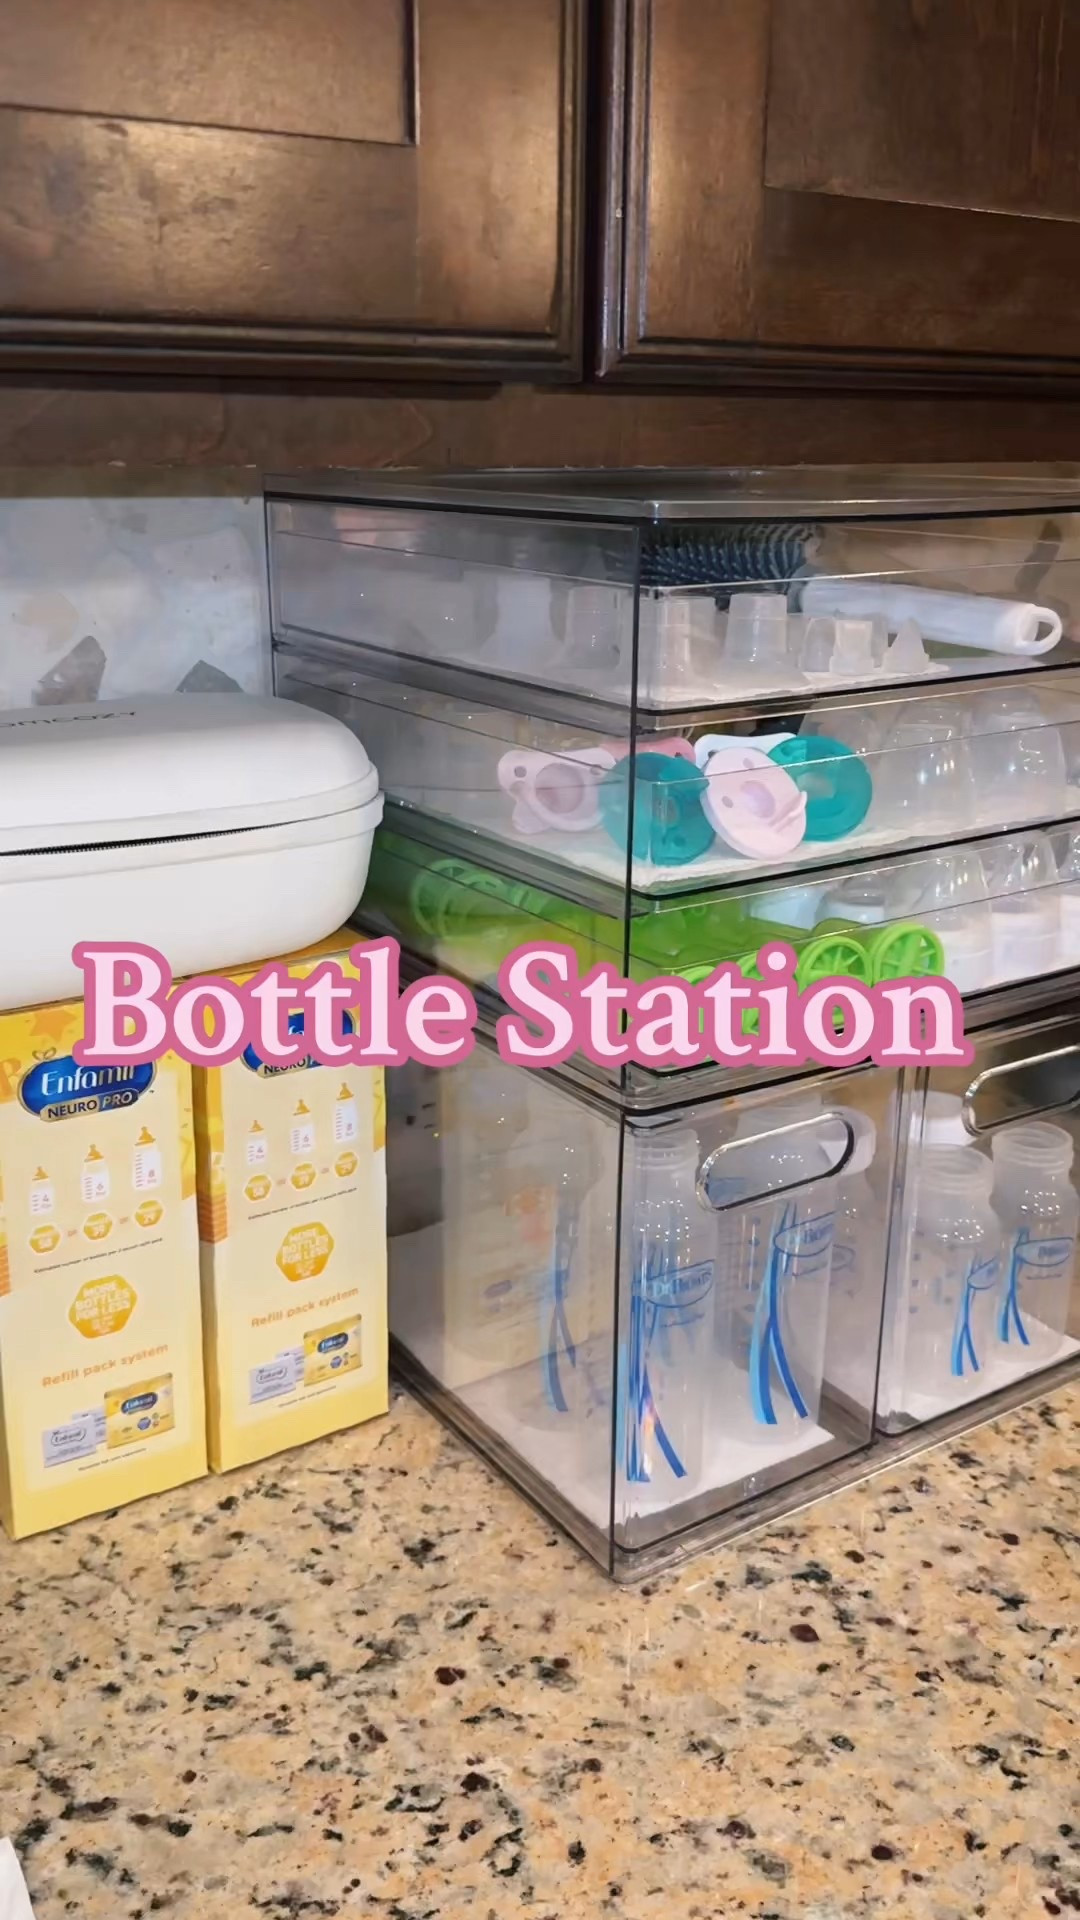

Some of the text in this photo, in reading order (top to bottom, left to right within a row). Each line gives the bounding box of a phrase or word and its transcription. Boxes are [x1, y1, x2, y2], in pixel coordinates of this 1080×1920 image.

[47, 1091, 133, 1119] NEURO PRO
[76, 1287, 130, 1311] BOTTLES
[251, 1288, 360, 1329] Refill pack system
[42, 1344, 169, 1388] Refill pack system
